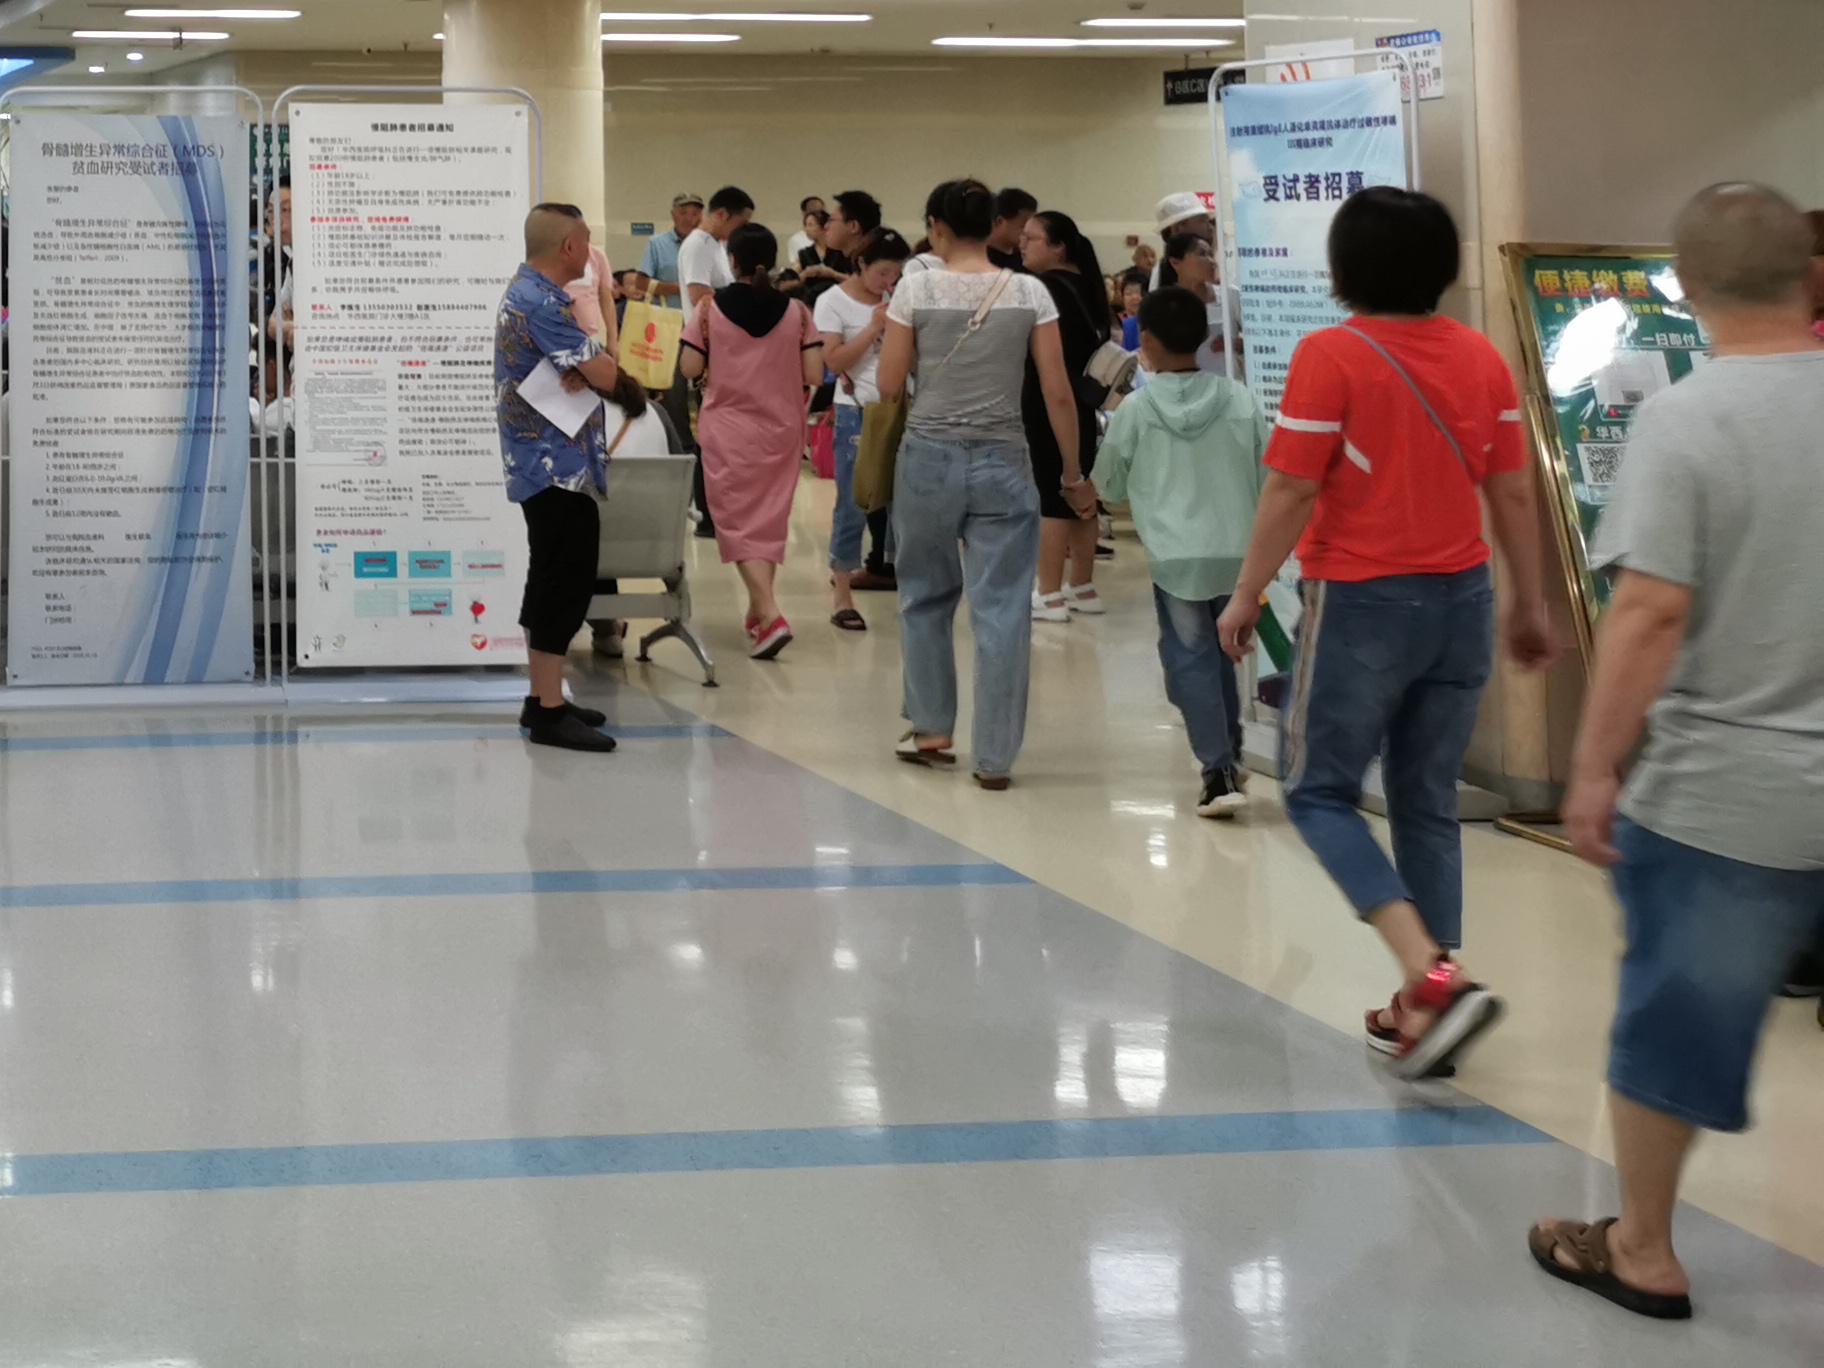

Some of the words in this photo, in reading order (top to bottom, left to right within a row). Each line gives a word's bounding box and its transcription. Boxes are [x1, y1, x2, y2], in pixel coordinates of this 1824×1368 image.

[1263, 170, 1364, 202] 受试者招募
[1535, 268, 1650, 298] 便捷缴费
